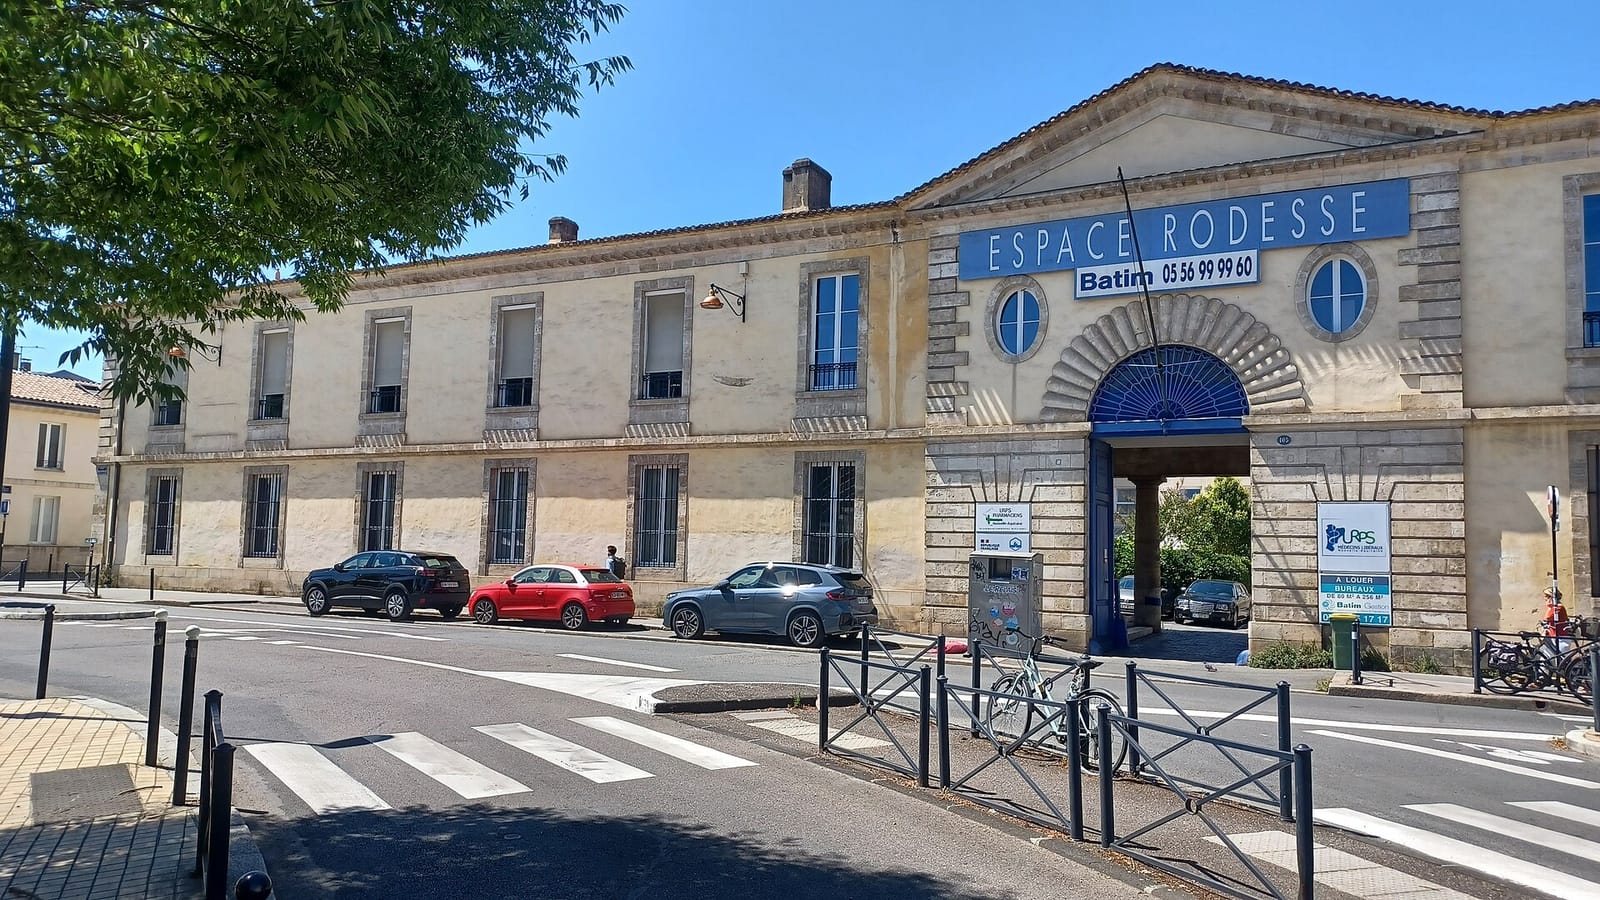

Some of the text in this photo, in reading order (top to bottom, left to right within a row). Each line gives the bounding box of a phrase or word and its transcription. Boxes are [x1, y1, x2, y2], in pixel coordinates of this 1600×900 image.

[989, 191, 1366, 272] ESPACE RODESSE
[1080, 255, 1252, 292] Batim 05 56 99 99 60
[1343, 529, 1376, 544] URPS
[1334, 585, 1375, 593] BUREAUX
[1337, 601, 1362, 609] Batim
[1364, 615, 1375, 623] 17
[1377, 616, 1389, 624] 17
